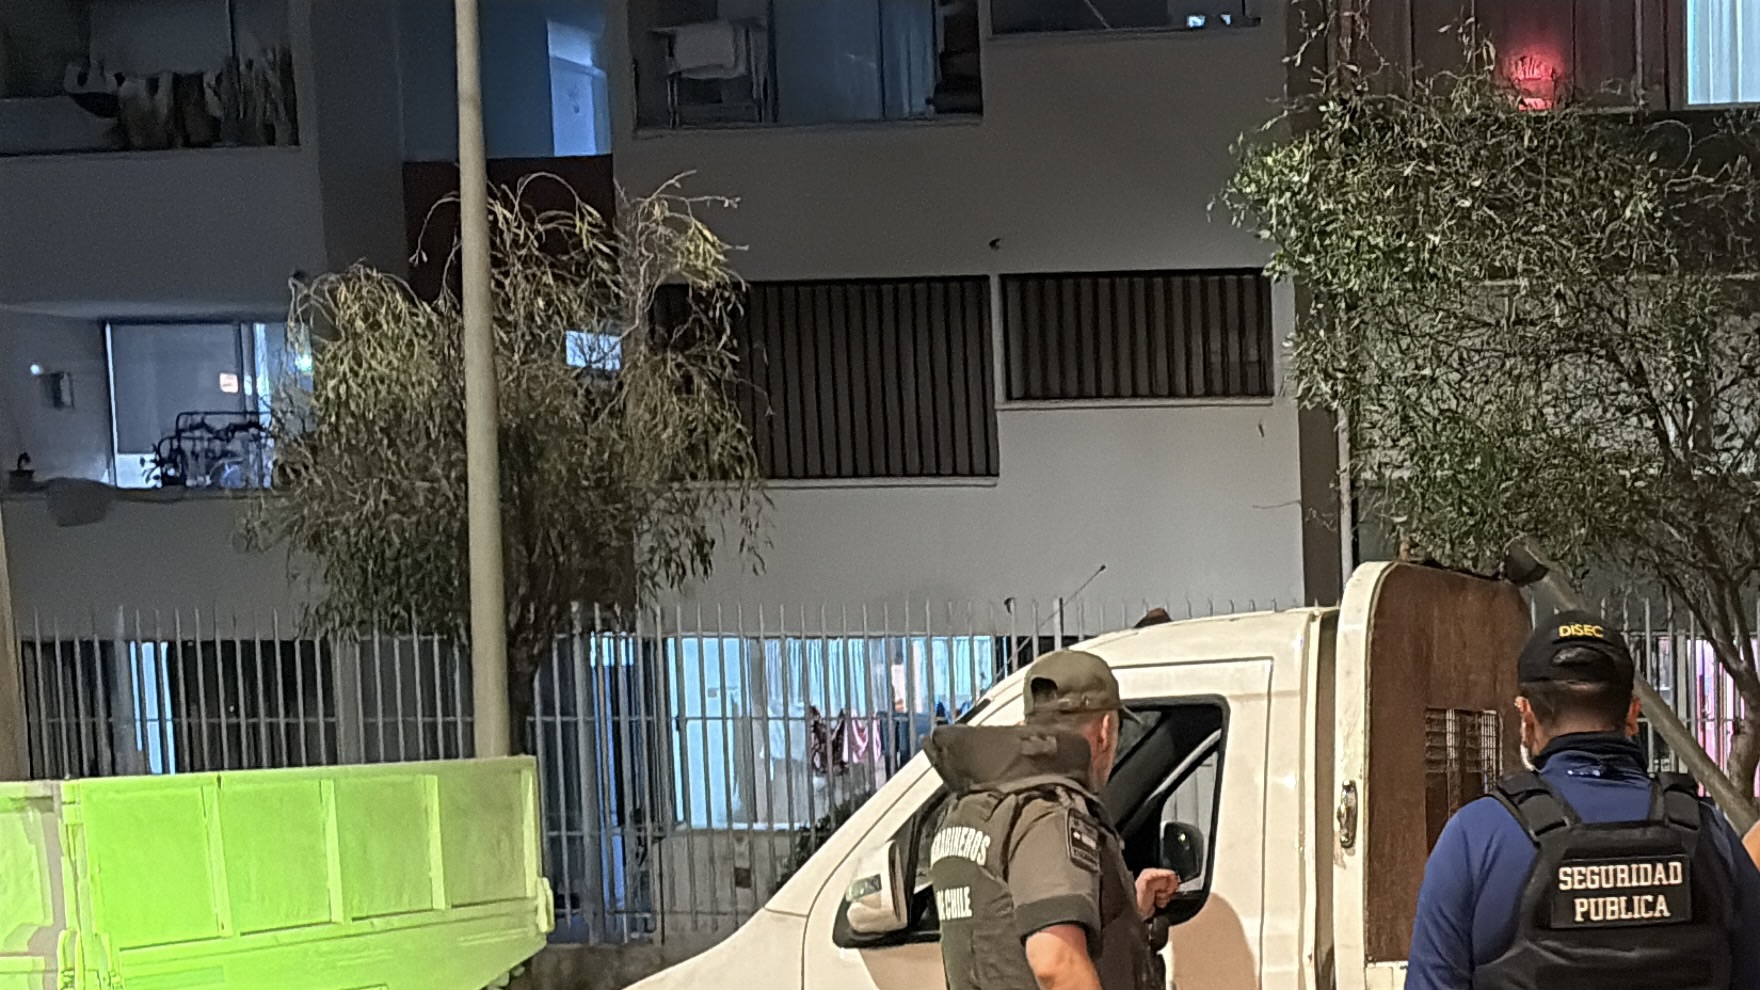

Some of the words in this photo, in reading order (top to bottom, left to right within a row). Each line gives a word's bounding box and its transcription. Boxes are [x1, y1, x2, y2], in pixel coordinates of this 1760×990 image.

[1559, 623, 1605, 639] DISEC
[1559, 861, 1683, 891] SEGURIDAD
[1573, 894, 1672, 922] PUBLICA
